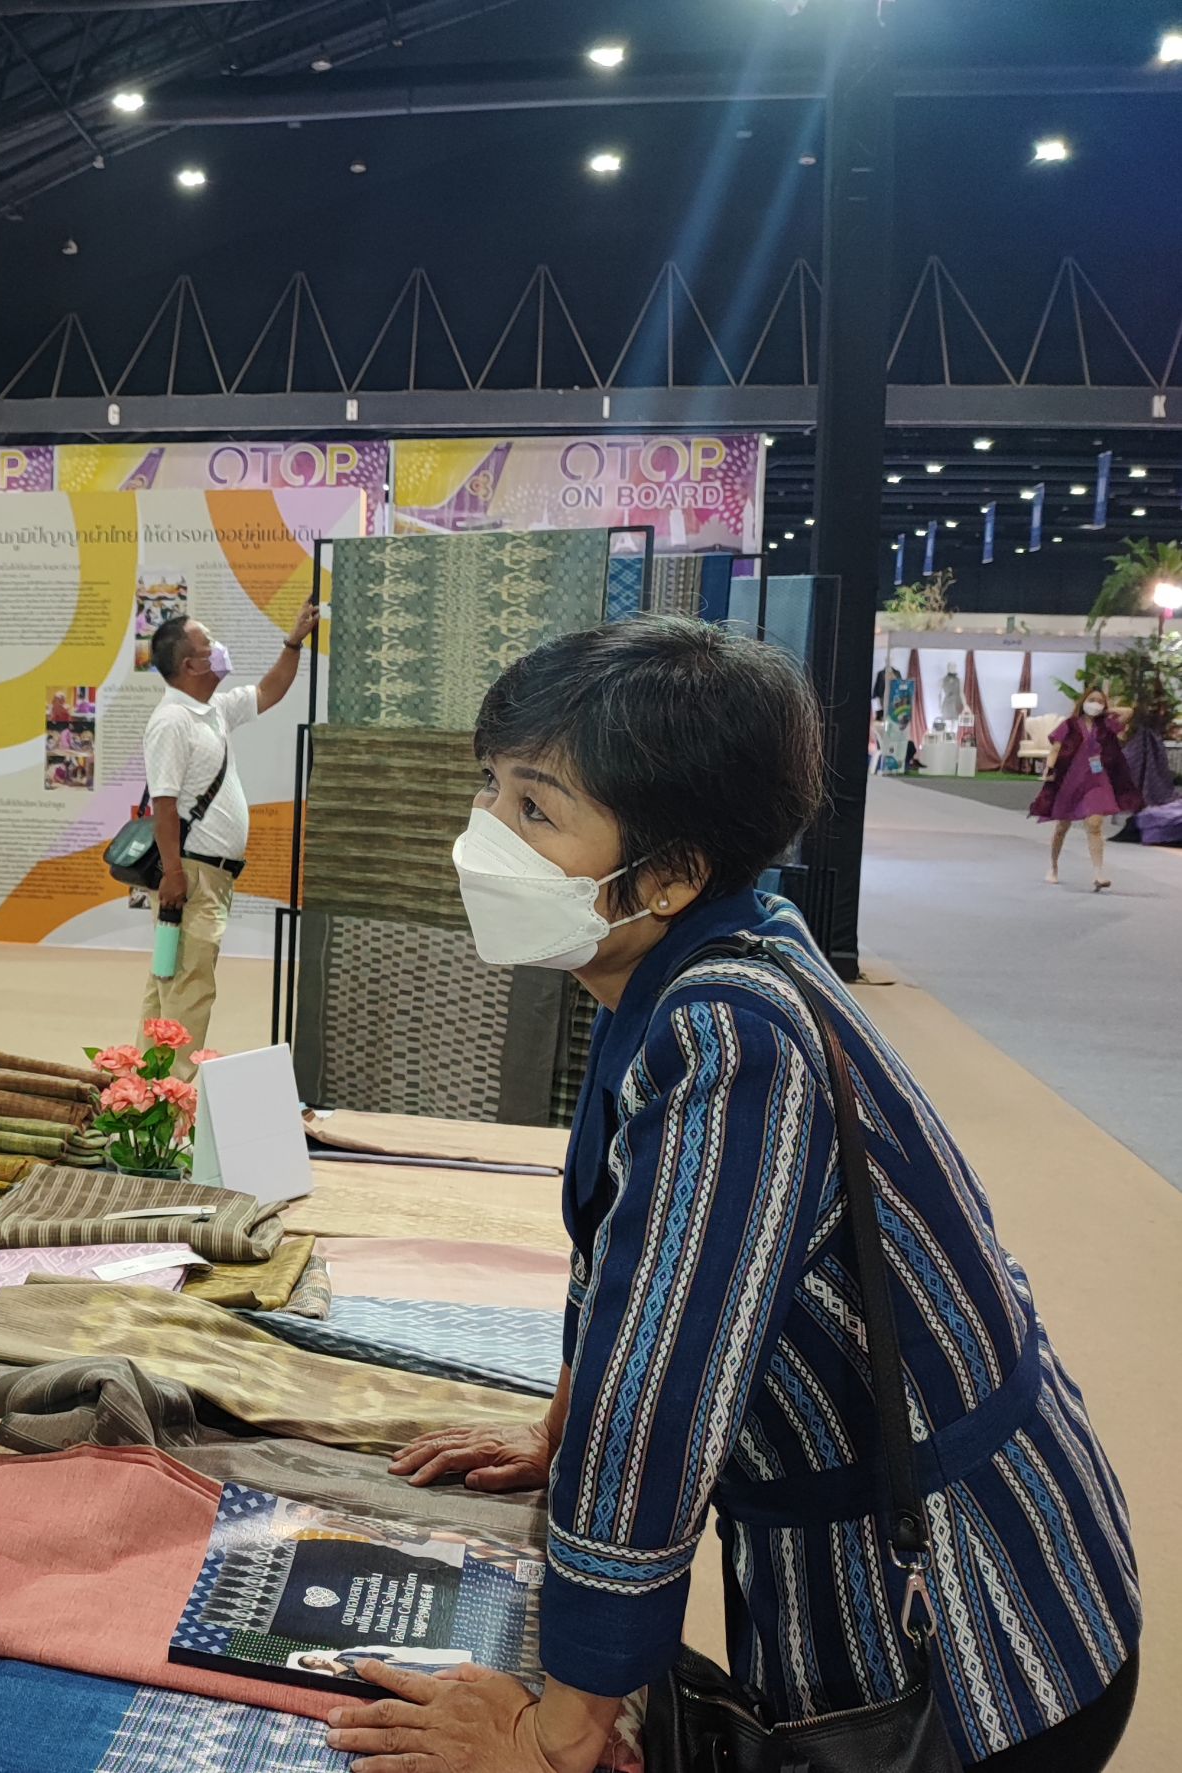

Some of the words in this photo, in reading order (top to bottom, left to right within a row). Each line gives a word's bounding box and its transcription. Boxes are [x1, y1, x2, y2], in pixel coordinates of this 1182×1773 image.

[108, 403, 120, 426] G
[1152, 395, 1166, 418] K
[208, 444, 357, 486] OTOP
[560, 439, 726, 482] OTOP
[562, 484, 603, 507] ON
[618, 484, 722, 507] BOARD
[381, 1580, 399, 1605] Sakon
[397, 1572, 418, 1615] Collection
[375, 1605, 394, 1633] Donkoi
[390, 1615, 410, 1644] Fashion
